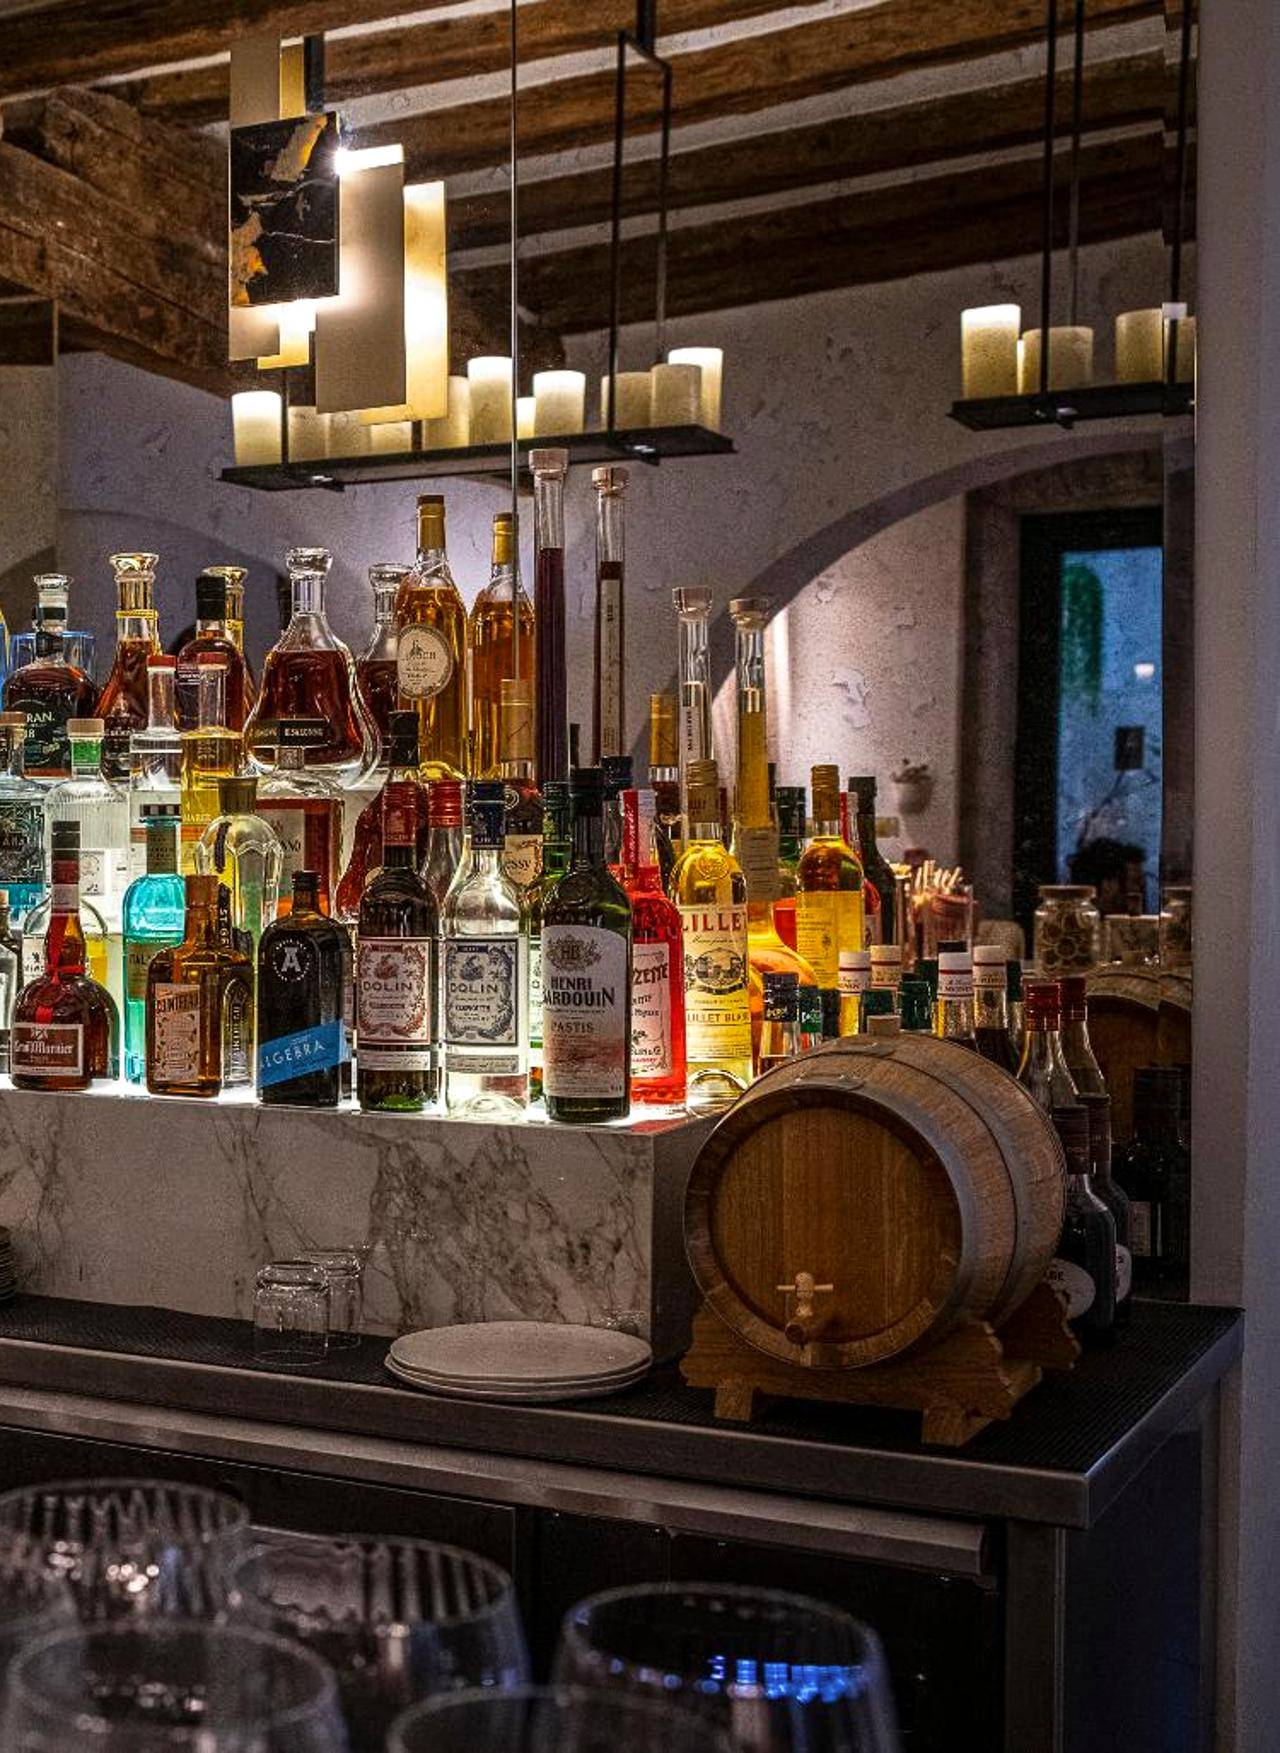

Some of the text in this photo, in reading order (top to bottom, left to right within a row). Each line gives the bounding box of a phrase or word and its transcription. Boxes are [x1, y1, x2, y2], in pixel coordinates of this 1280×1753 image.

[363, 981, 413, 993] DOLIN
[449, 982, 498, 994] DOLIN
[550, 976, 592, 991] HENRI
